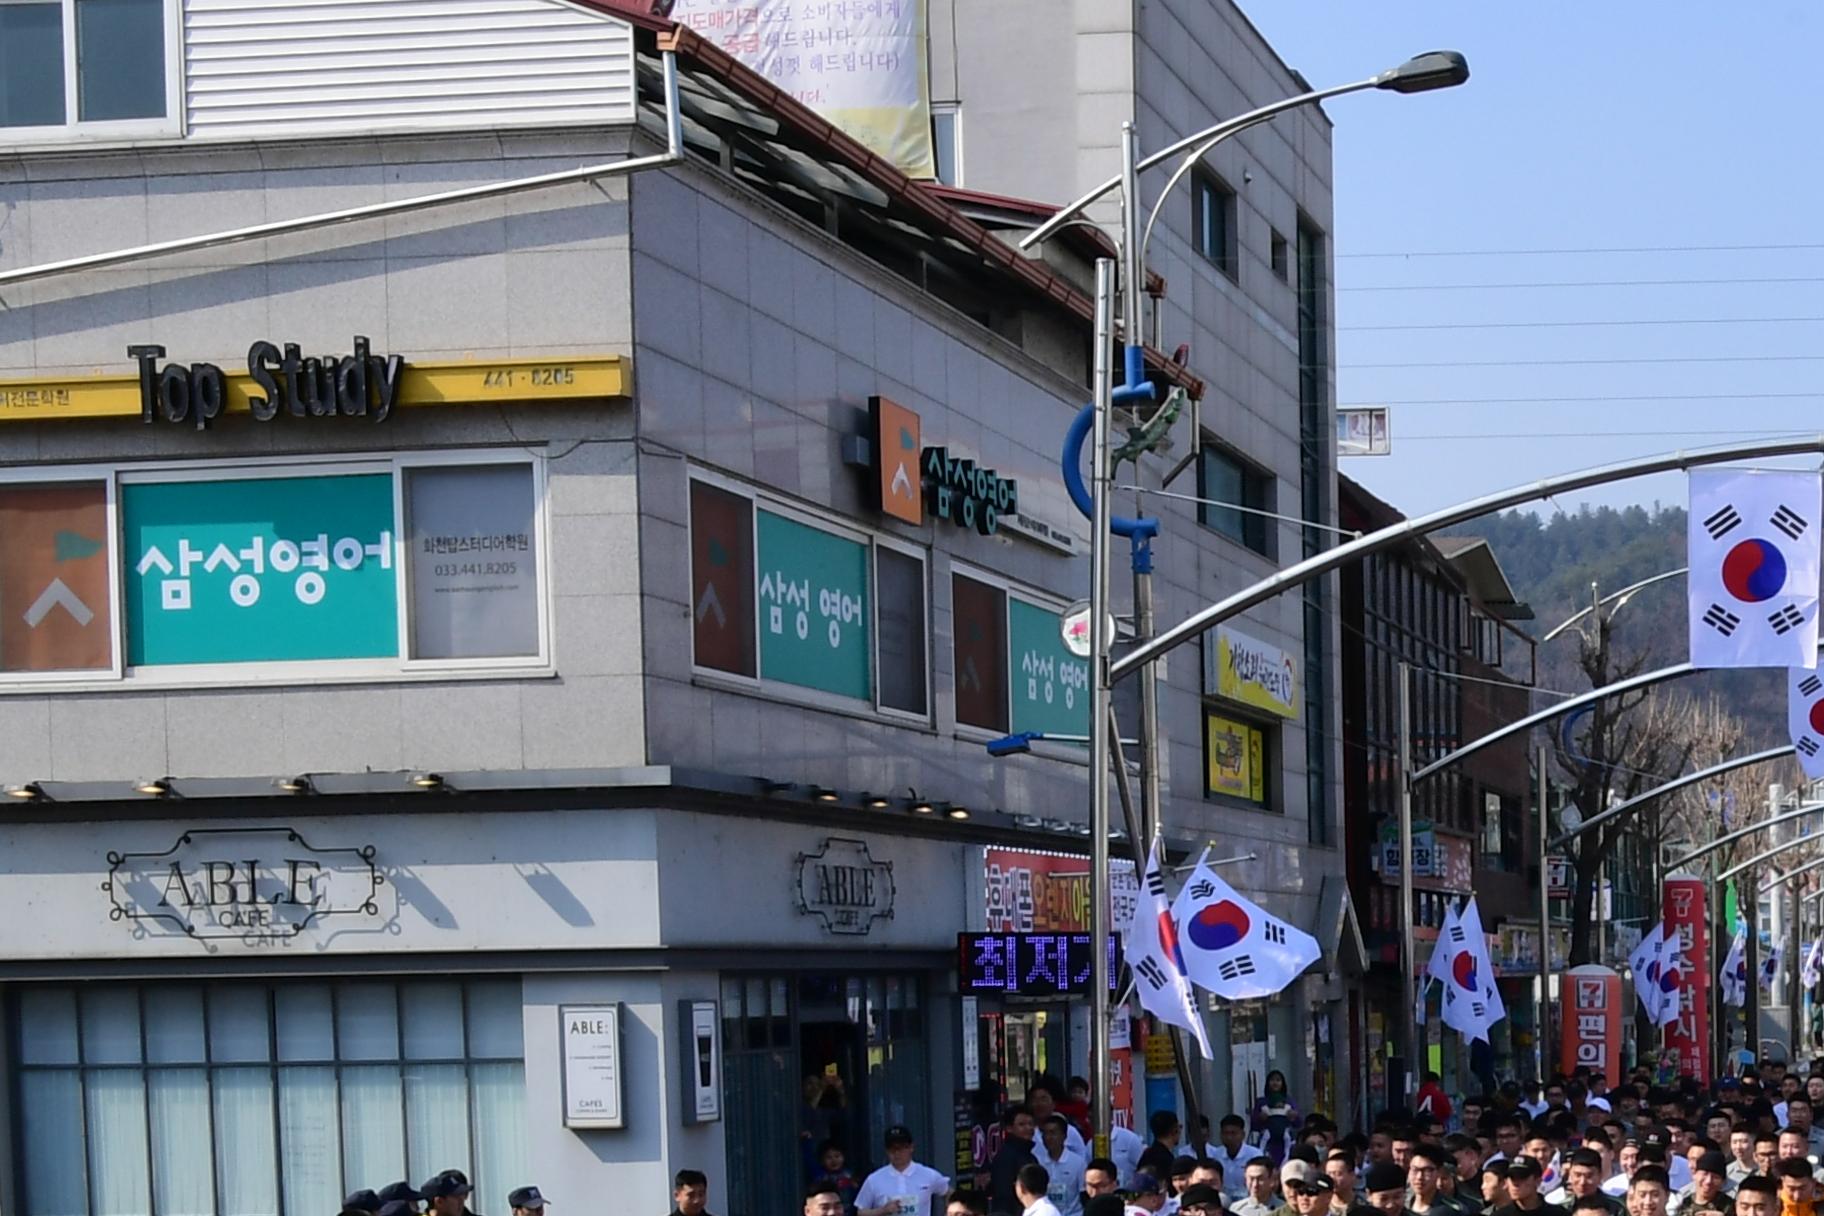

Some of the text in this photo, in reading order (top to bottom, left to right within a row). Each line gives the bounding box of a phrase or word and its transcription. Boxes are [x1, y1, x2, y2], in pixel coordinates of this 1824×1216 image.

[127, 335, 404, 430] Top Study
[137, 530, 391, 611] 삼성영어
[760, 571, 863, 649] 삼성 영어
[158, 858, 322, 908] ABLE
[814, 864, 876, 907] ABLE
[218, 909, 271, 929] CAFE
